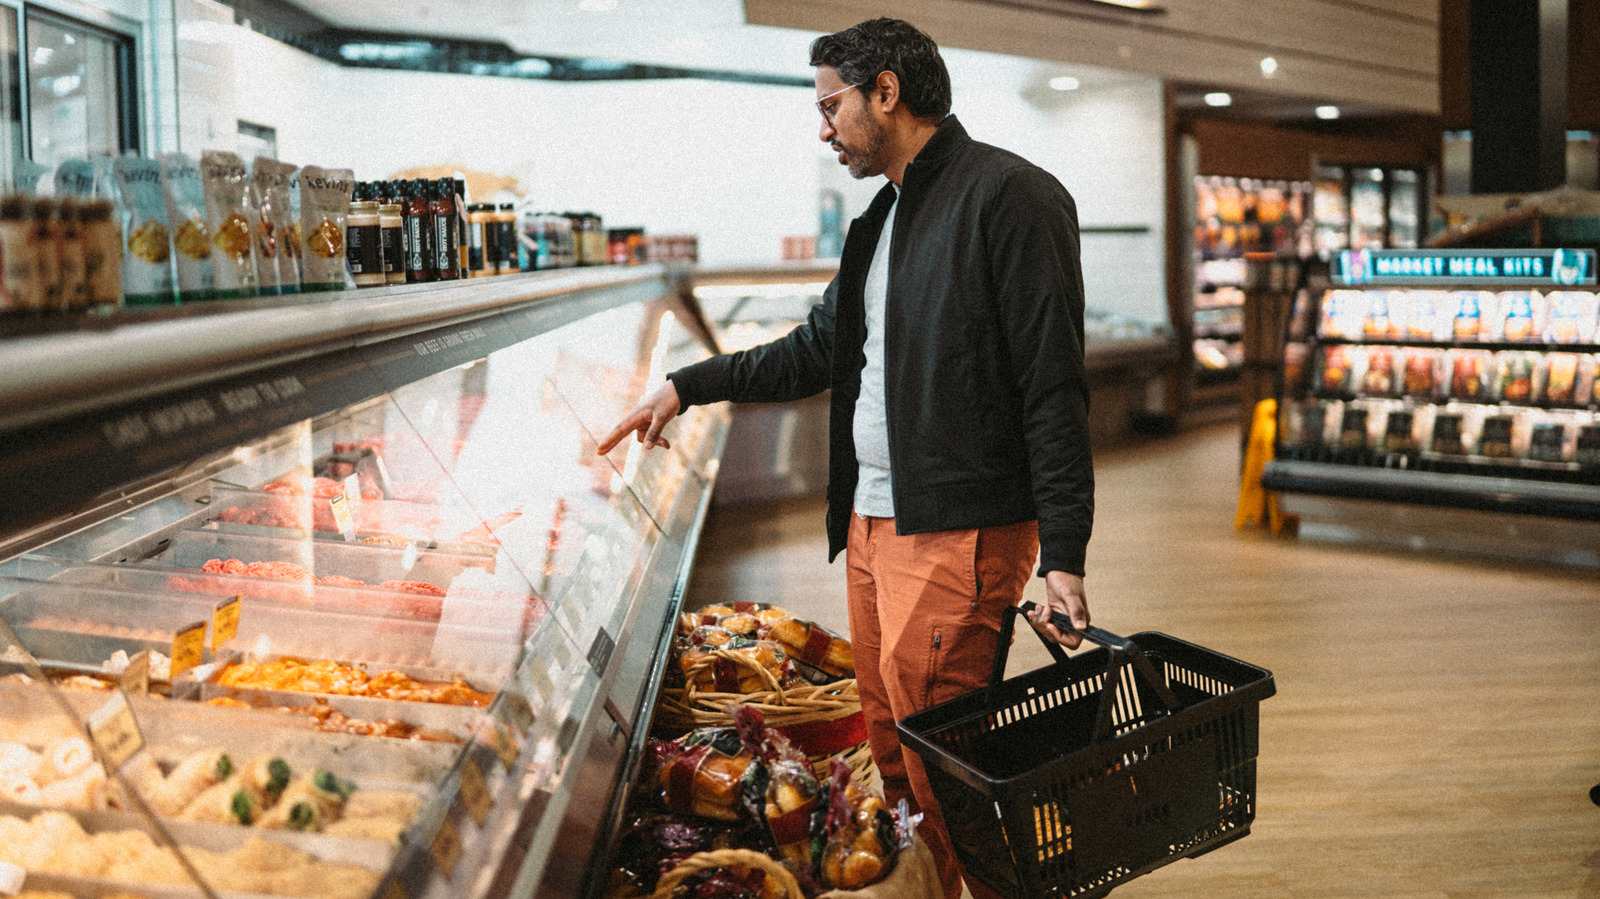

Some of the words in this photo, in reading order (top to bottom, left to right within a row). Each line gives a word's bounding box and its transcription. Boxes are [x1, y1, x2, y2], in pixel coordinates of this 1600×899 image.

[1376, 257, 1445, 276] MARKET
[1449, 257, 1499, 276] MEAL
[1503, 257, 1545, 276] KITS
